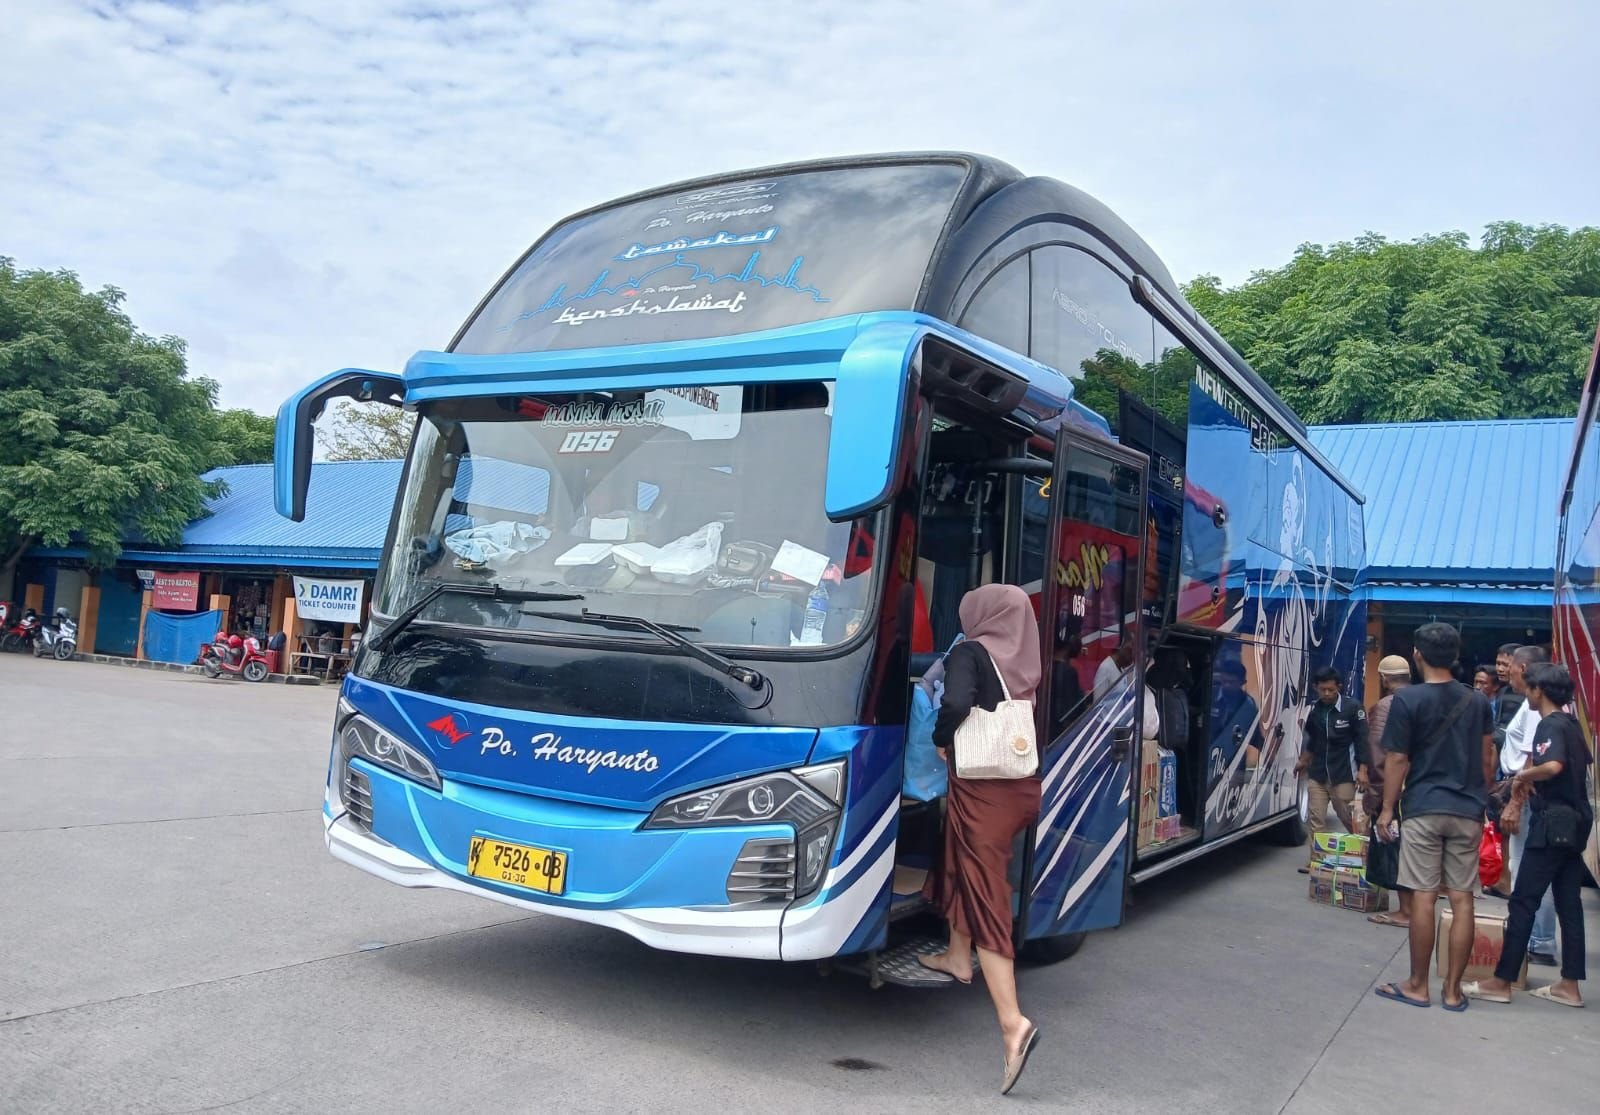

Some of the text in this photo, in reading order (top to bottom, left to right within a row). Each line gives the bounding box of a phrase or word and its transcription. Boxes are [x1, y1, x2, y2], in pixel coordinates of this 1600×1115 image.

[685, 203, 775, 223] Haryanto
[557, 430, 619, 453] 056
[311, 585, 358, 601] DAMRI
[299, 599, 356, 611] TICKET COUNTER
[1072, 594, 1086, 617] 056
[480, 727, 659, 774] Po. Haryanto
[494, 844, 530, 872] 7526
